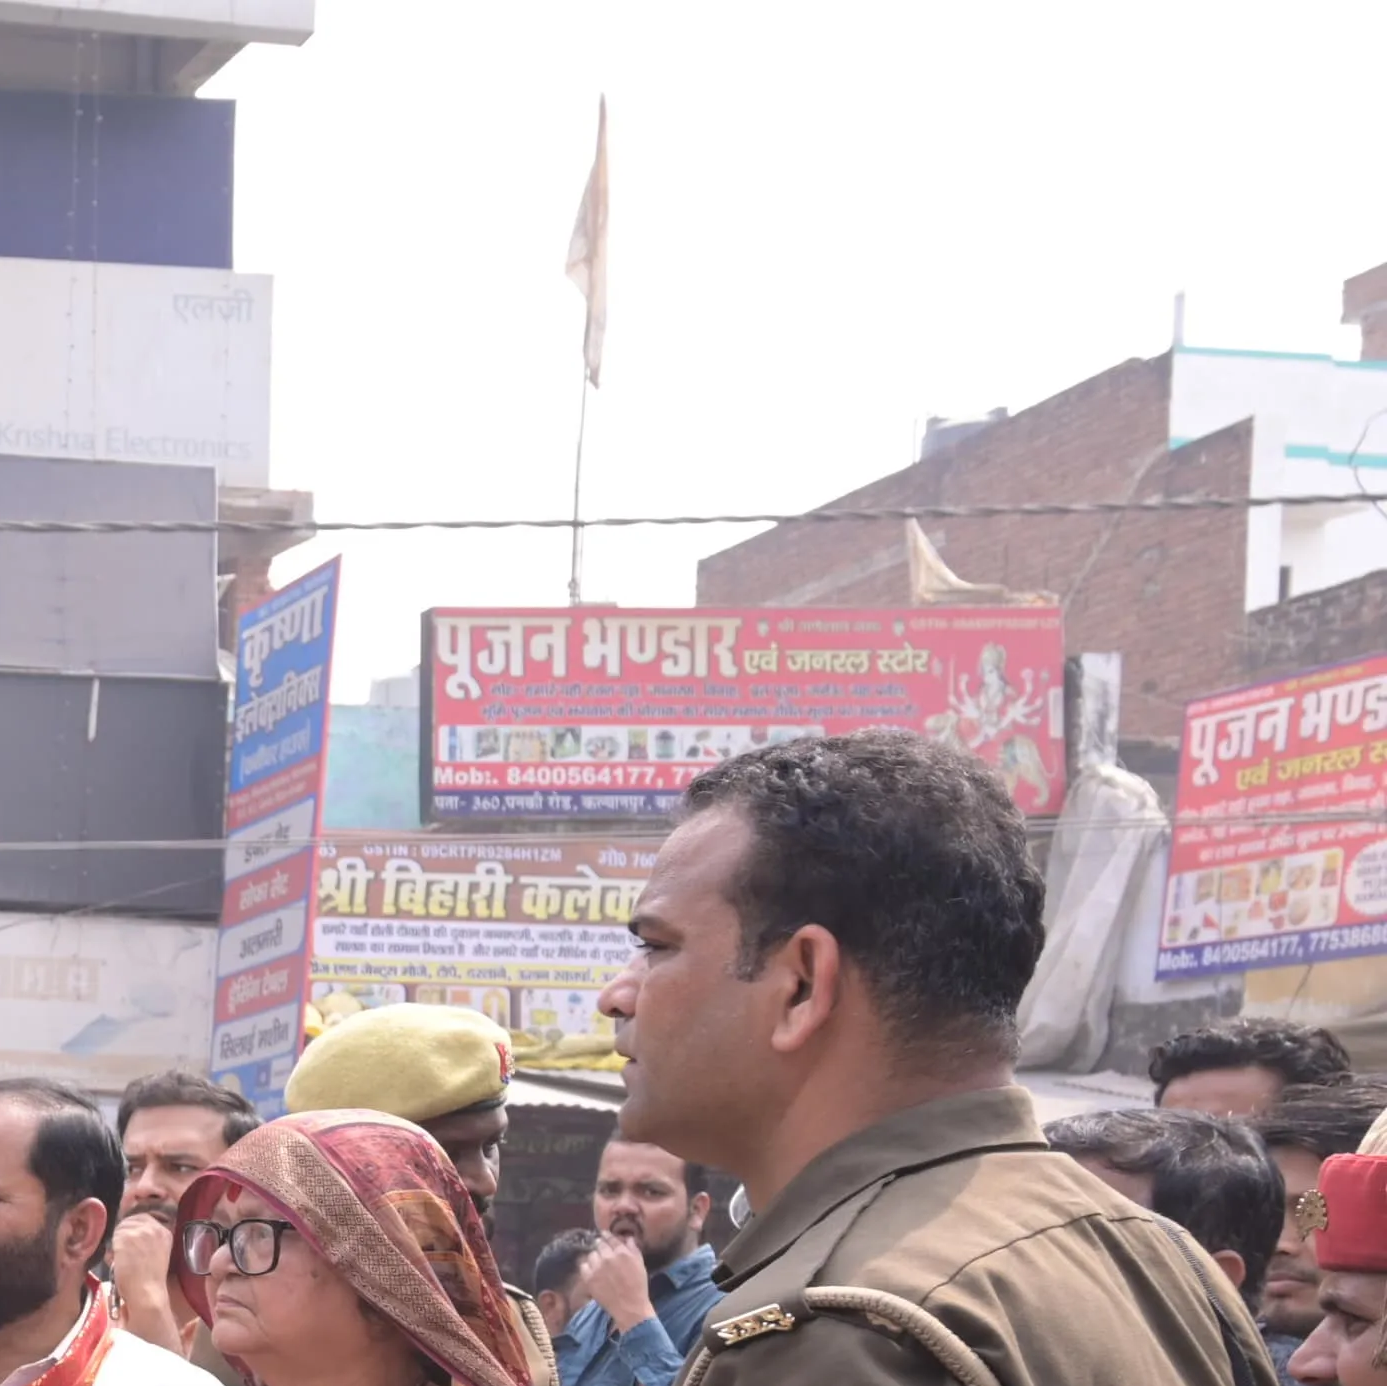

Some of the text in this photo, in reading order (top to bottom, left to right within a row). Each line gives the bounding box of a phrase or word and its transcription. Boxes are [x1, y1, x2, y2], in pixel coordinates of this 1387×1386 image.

[105, 425, 252, 461] Electronics
[241, 585, 329, 688] कृष्णा
[434, 616, 931, 701] पूजन भण्डार एवं जनरल स्टोर
[1189, 673, 1387, 787] पूजन भण्ड
[1235, 757, 1271, 791] एवं
[1277, 745, 1364, 781] जनरल
[318, 857, 375, 915] श्री
[381, 857, 514, 919] बिहारी
[239, 917, 284, 960] अलमारी
[220, 1016, 290, 1060] सिलाई मशीन
